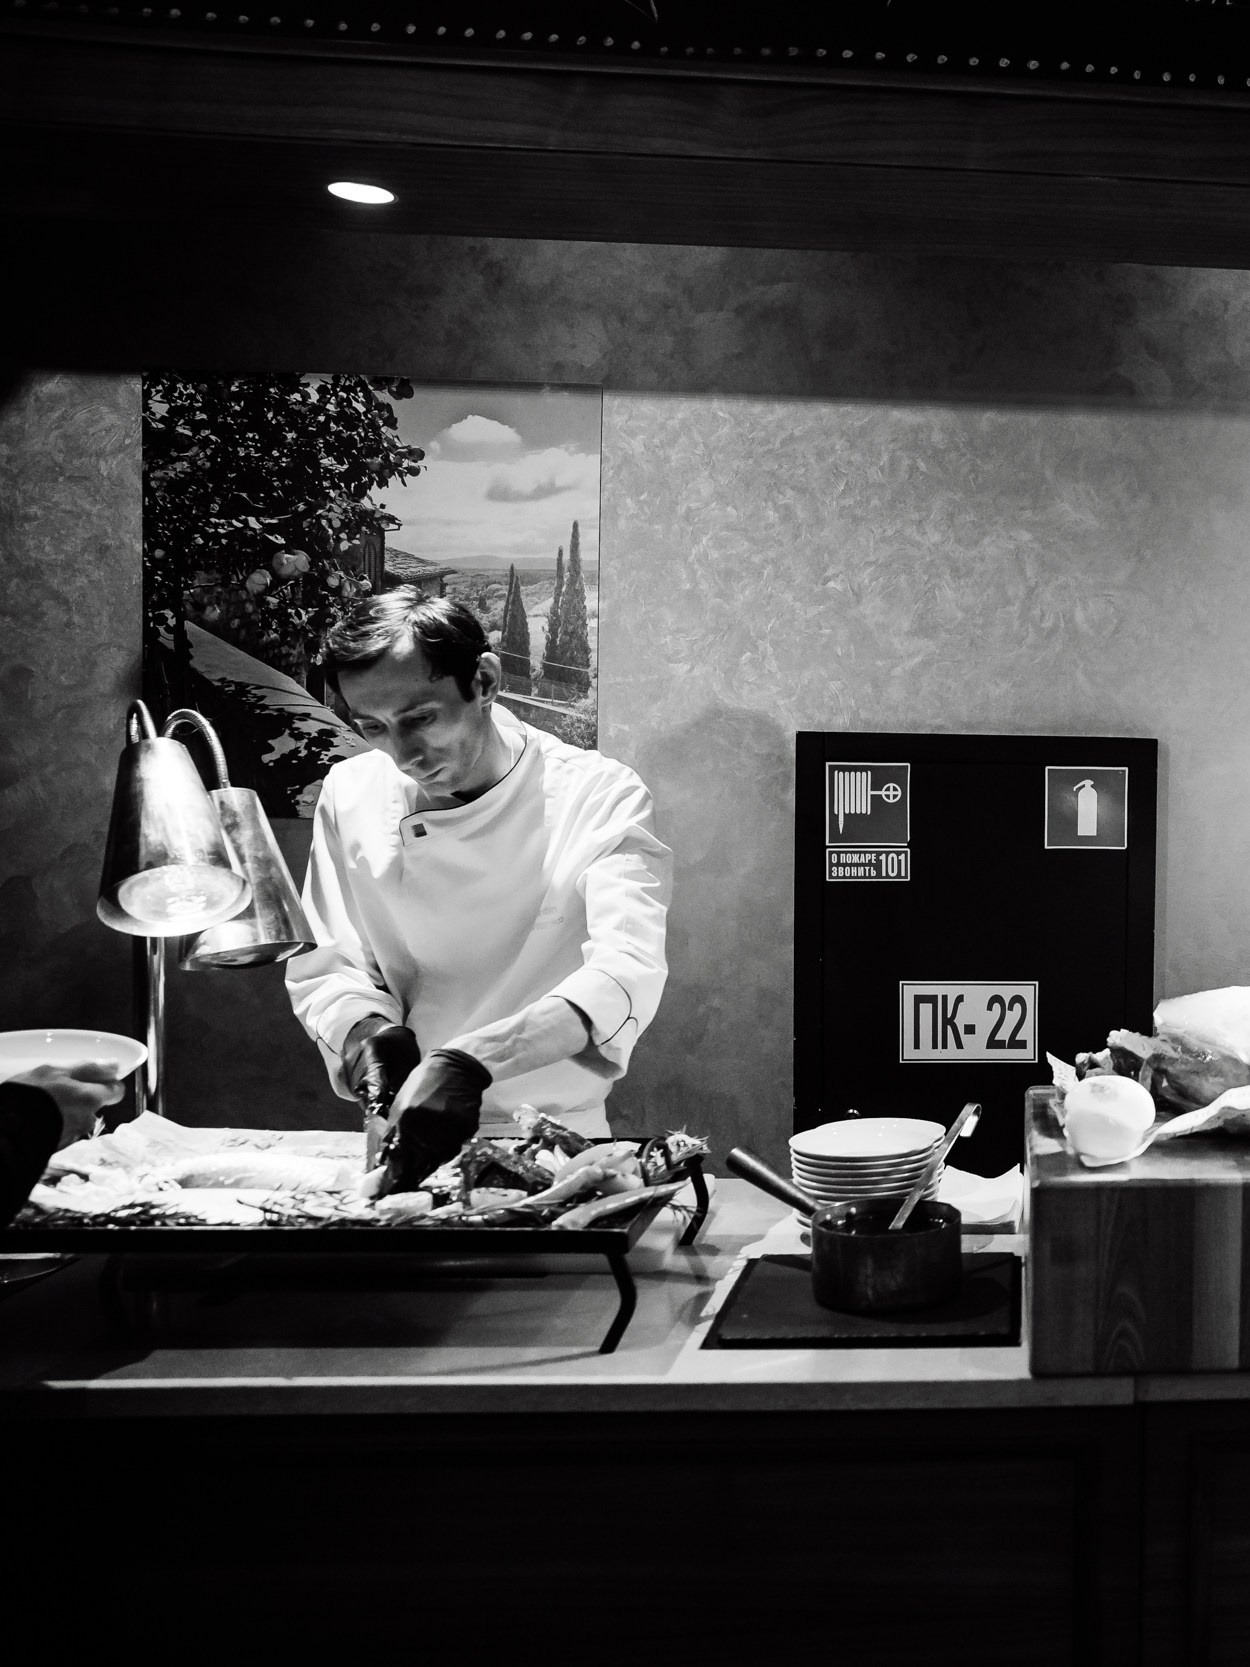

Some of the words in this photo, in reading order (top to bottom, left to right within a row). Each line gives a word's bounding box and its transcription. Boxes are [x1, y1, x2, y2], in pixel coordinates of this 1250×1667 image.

[831, 853, 838, 864] О
[840, 853, 877, 864] ПОЖАРЕ
[879, 852, 906, 878] 101
[831, 866, 877, 877] ЗВОНИТЬ
[913, 994, 976, 1050] ПК-
[985, 994, 1028, 1050] 22
